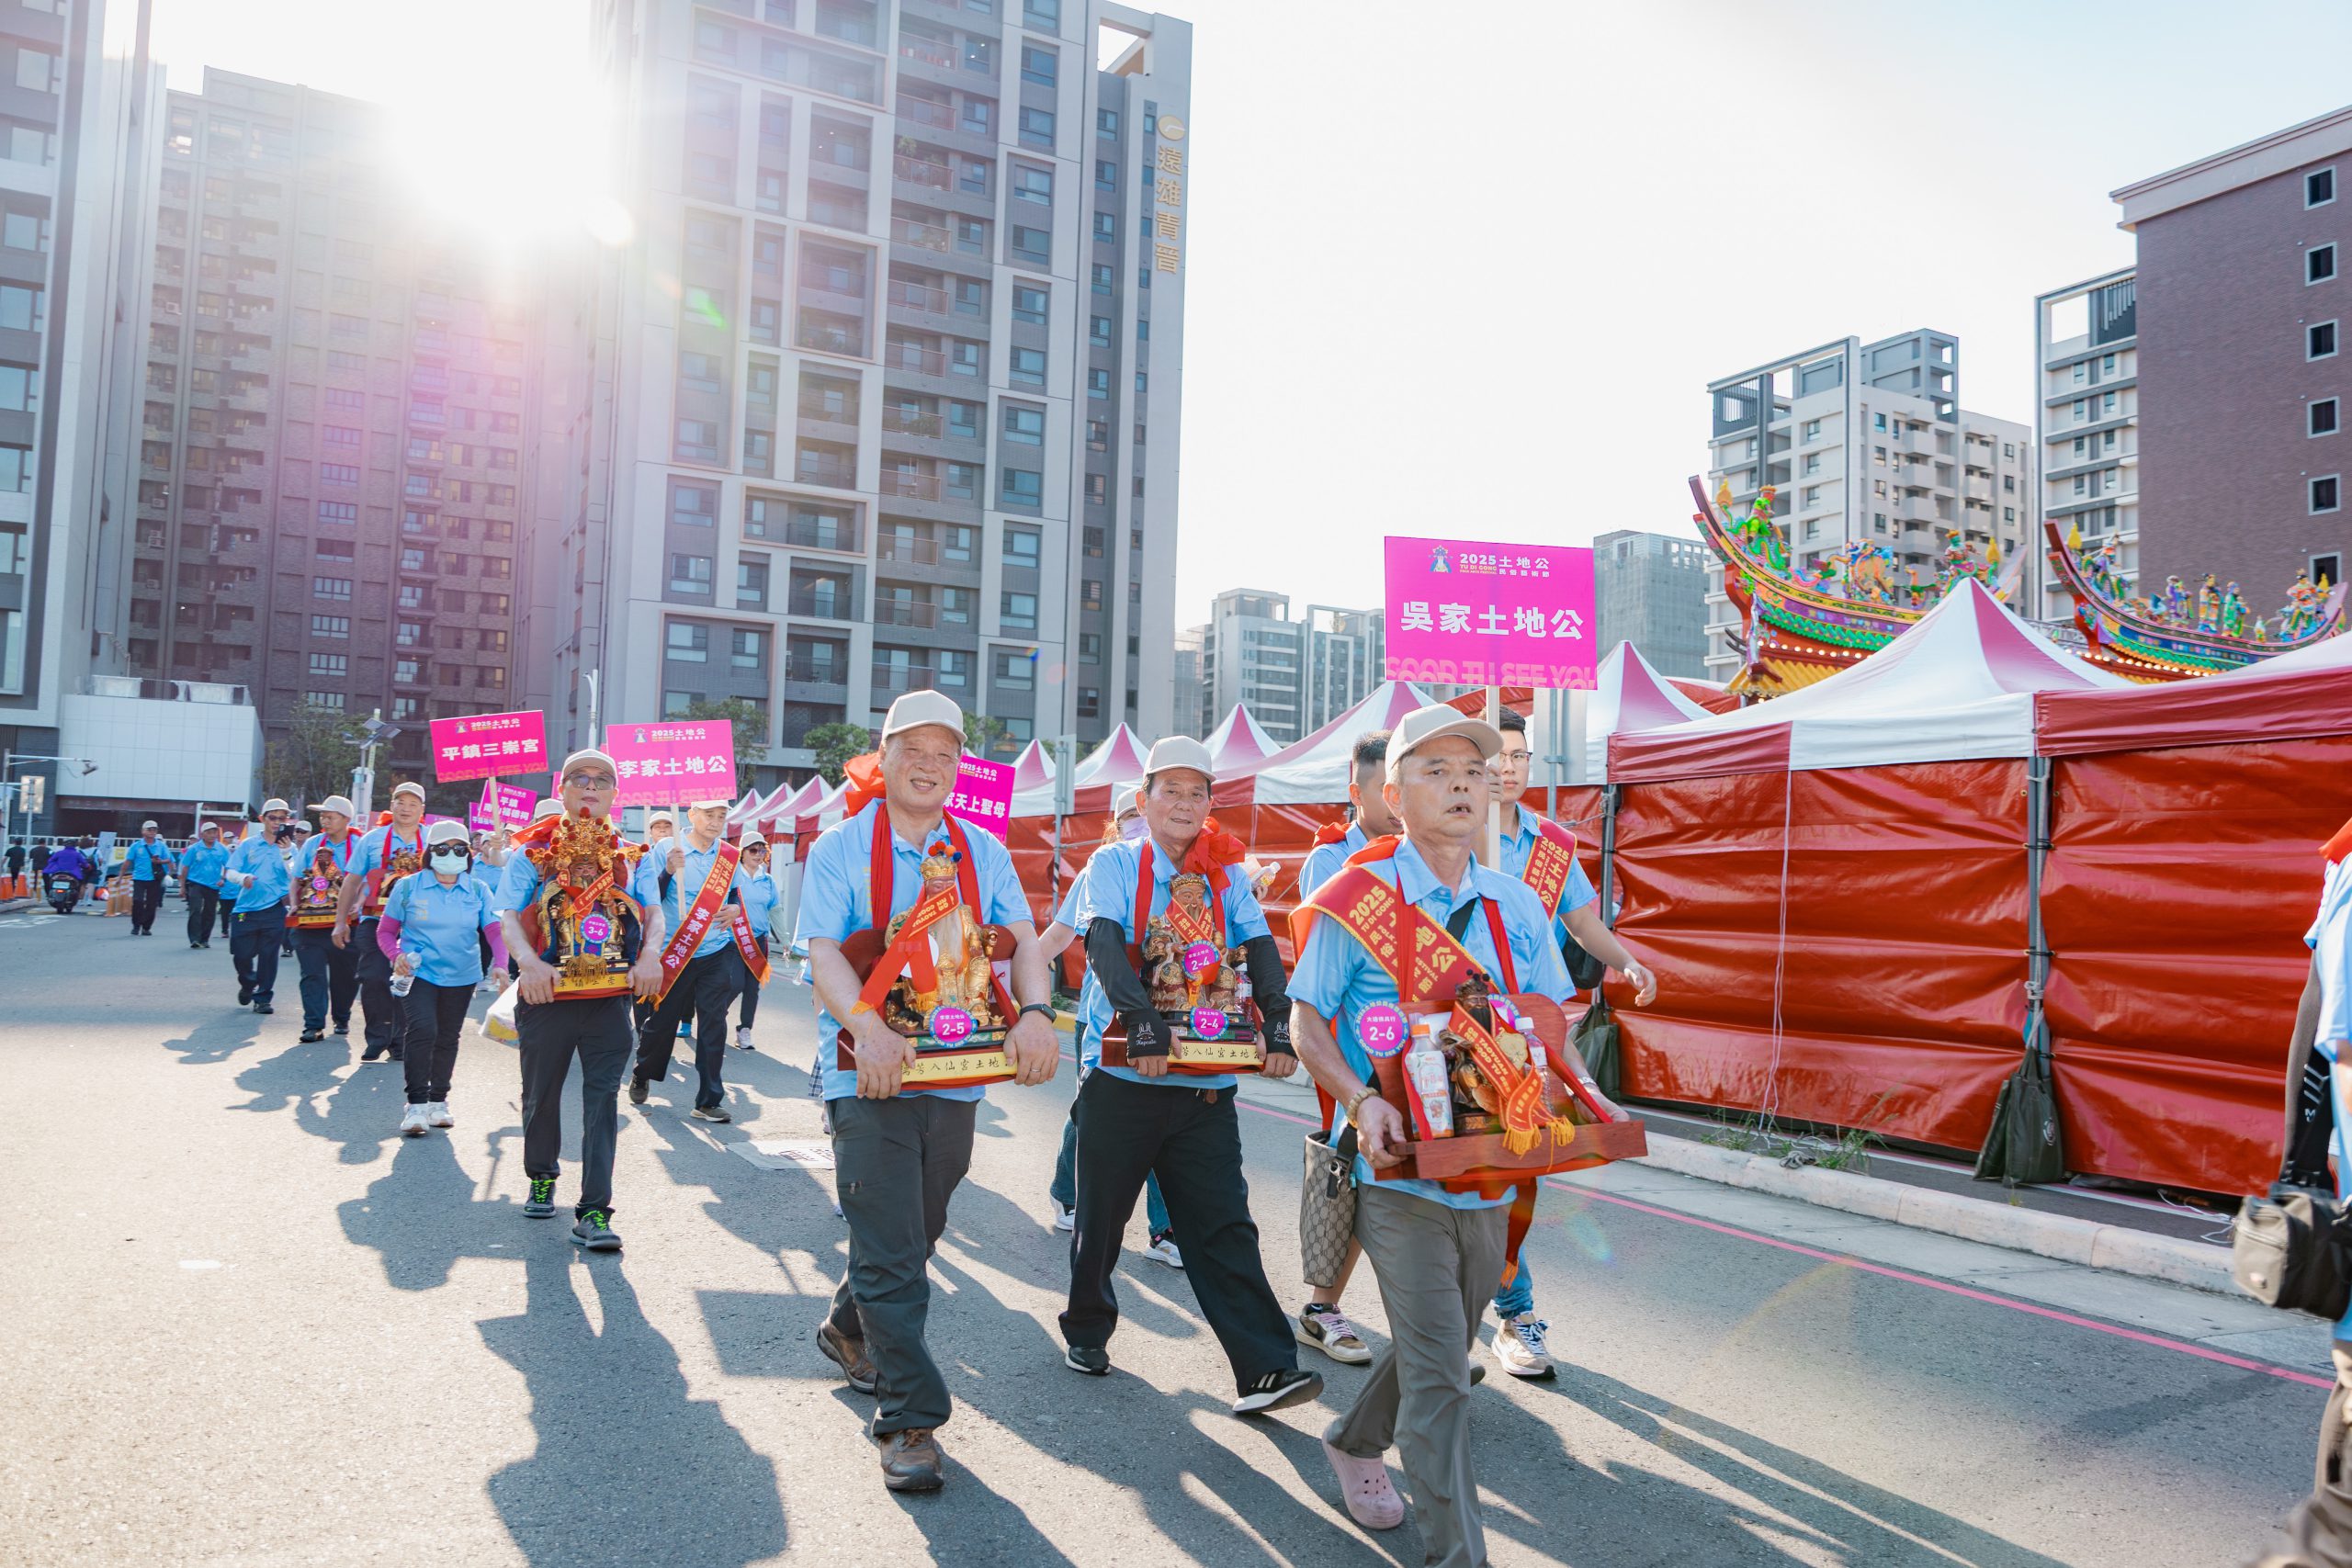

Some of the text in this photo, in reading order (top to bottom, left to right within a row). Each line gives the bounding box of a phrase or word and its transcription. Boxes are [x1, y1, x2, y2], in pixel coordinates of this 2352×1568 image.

[1400, 601, 1584, 640] 吳家土地公
[442, 739, 538, 761] 平鎮三崇宮
[617, 755, 728, 779] 李家土地公
[1541, 836, 1569, 861] 2025
[1540, 862, 1564, 908] 土地公
[1349, 886, 1387, 926] 2025
[588, 926, 605, 937] 3-6
[1360, 922, 1370, 932] TU
[1377, 924, 1396, 942] FOLK
[665, 907, 710, 968] 李家土地公
[1191, 956, 1211, 971] 2-4
[942, 1021, 965, 1036] 2-5
[1200, 1018, 1218, 1029] 2-4
[1369, 1025, 1395, 1041] 2-6
[1479, 1038, 1510, 1077] TAOYUAN
[1490, 1064, 1501, 1075] TU
